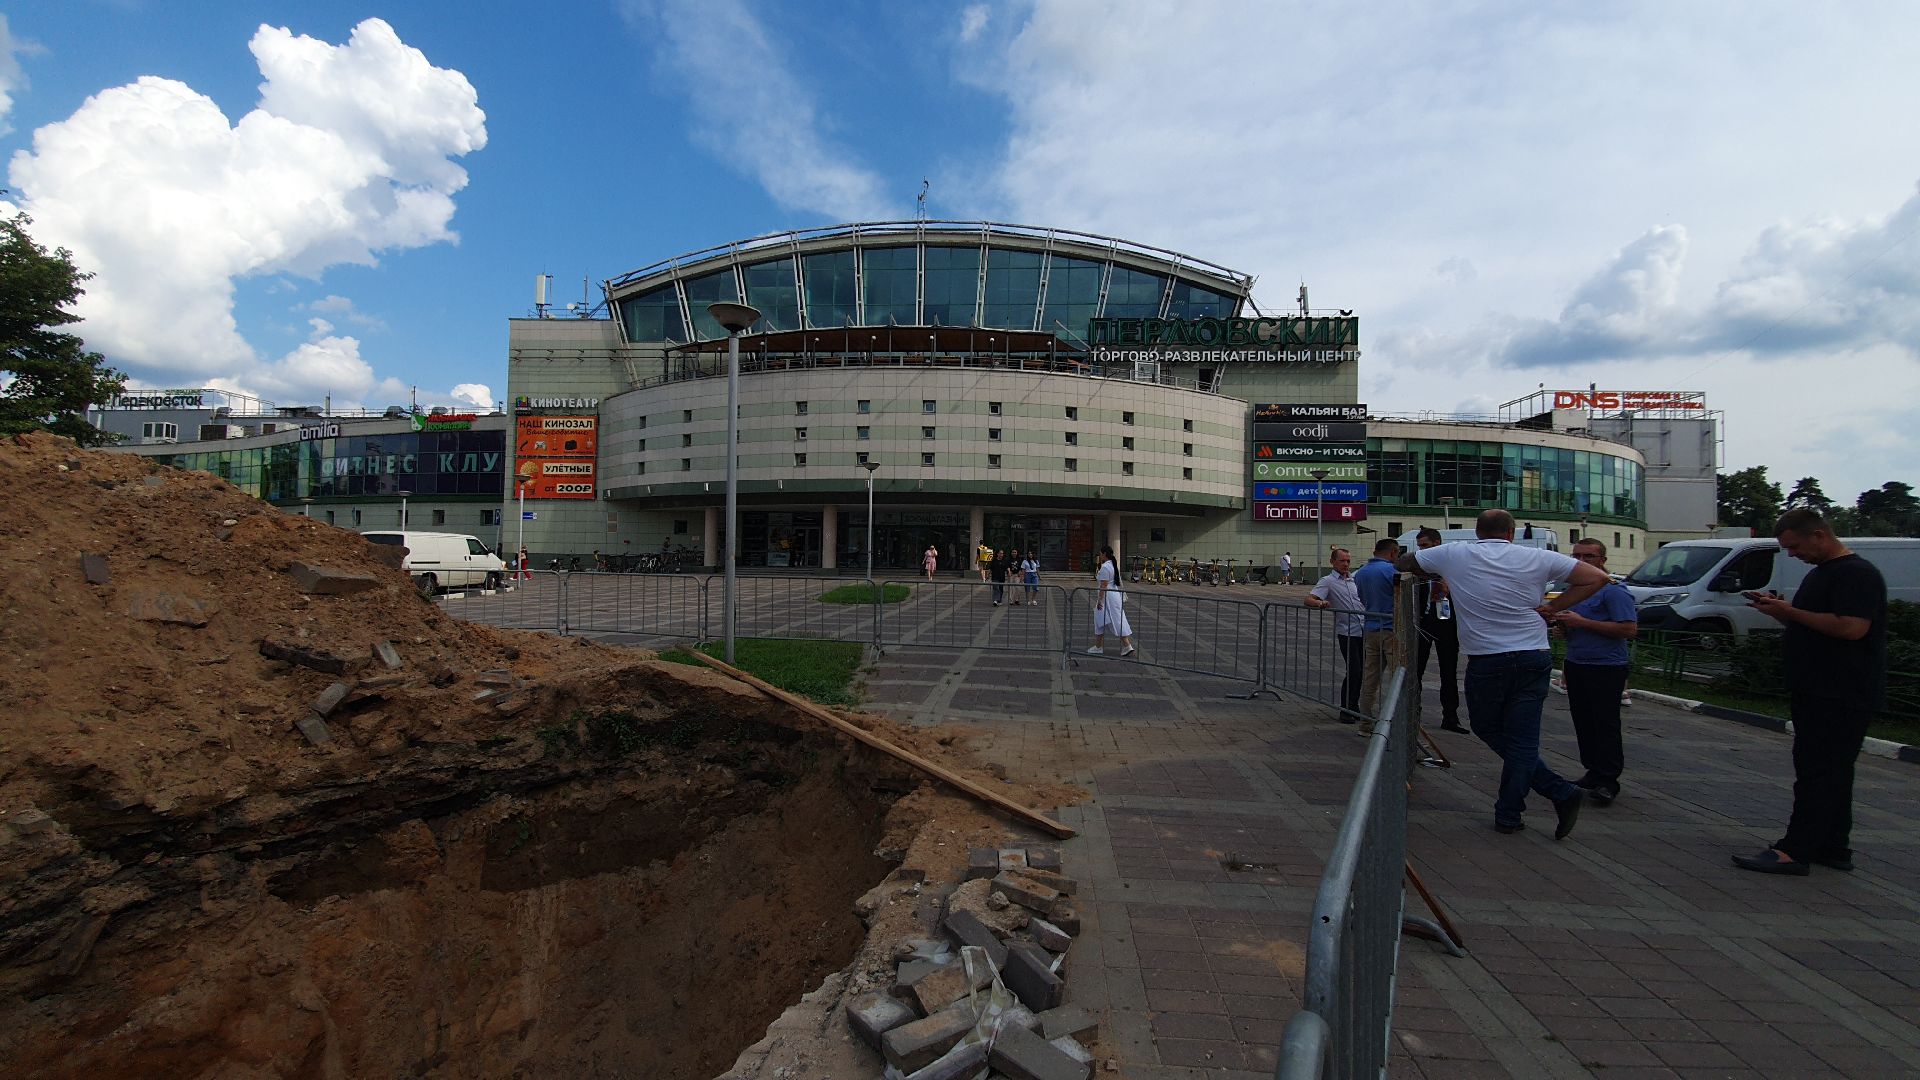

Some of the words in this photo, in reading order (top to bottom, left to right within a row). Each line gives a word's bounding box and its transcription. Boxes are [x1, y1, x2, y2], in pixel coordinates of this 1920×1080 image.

[1089, 310, 1359, 346] ПЕРЛОВСКИЙ
[1092, 348, 1310, 363] ТОРГОВО-РАЗВЛЕКАТЕЛЬНЫЙ
[1315, 350, 1361, 364] ЦЕНТР
[531, 398, 598, 408] КИНОТЕАТР
[1554, 391, 1619, 409] DNS
[1291, 407, 1339, 416] КАЛЬЯН
[1341, 407, 1365, 416] БАР
[519, 420, 542, 428] НАШ
[544, 420, 593, 428] КИНОЗАЛ
[1292, 424, 1328, 440] oodji
[1276, 448, 1314, 456] ВКУСНО
[1323, 448, 1330, 456] И
[1332, 448, 1364, 456] ТОЧКА
[440, 452, 499, 473] КЛУ
[545, 464, 591, 473] УЛЁТНЫЕ
[1340, 489, 1358, 497] мир
[1265, 504, 1319, 519] familia
